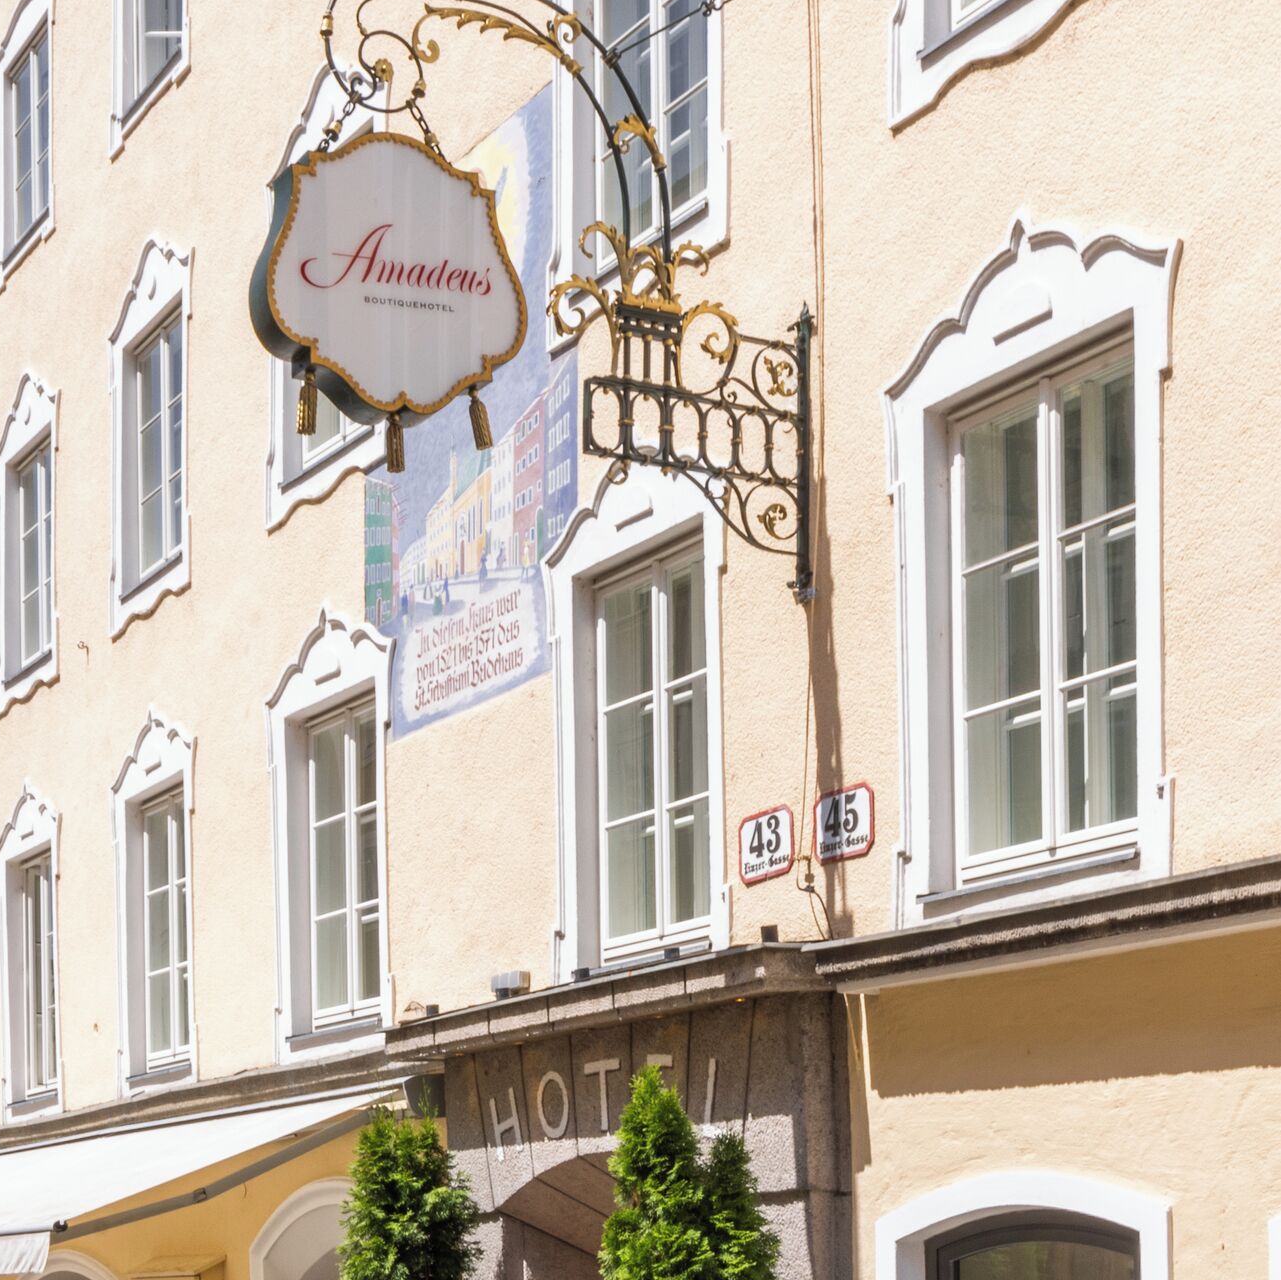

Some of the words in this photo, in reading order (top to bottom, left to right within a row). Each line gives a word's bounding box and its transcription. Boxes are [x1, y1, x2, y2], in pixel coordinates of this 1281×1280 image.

[300, 223, 492, 297] Amadeus
[364, 295, 455, 313] BOUTIQUEHOTEL
[496, 588, 521, 618] war
[497, 618, 521, 646] das
[748, 814, 782, 859] 43
[824, 791, 859, 838] 45
[488, 1053, 723, 1163] HOTL
